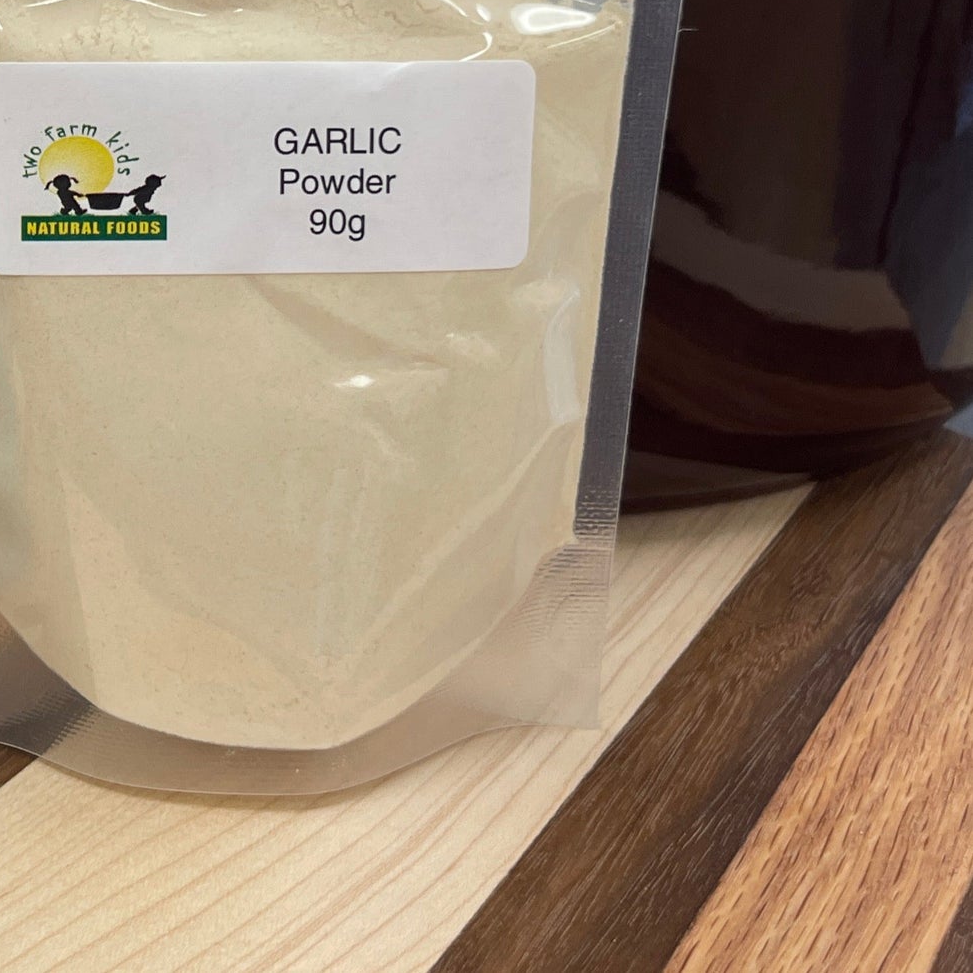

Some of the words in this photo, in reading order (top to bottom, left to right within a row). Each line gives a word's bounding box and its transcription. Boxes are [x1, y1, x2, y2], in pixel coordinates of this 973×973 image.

[22, 145, 42, 179] two
[44, 123, 98, 142] farm
[105, 131, 140, 177] kids
[273, 126, 402, 156] GARLIC
[279, 167, 397, 195] Powder
[27, 221, 100, 236] NATURAL
[107, 221, 161, 235] FOODS
[309, 208, 366, 242] 90g
